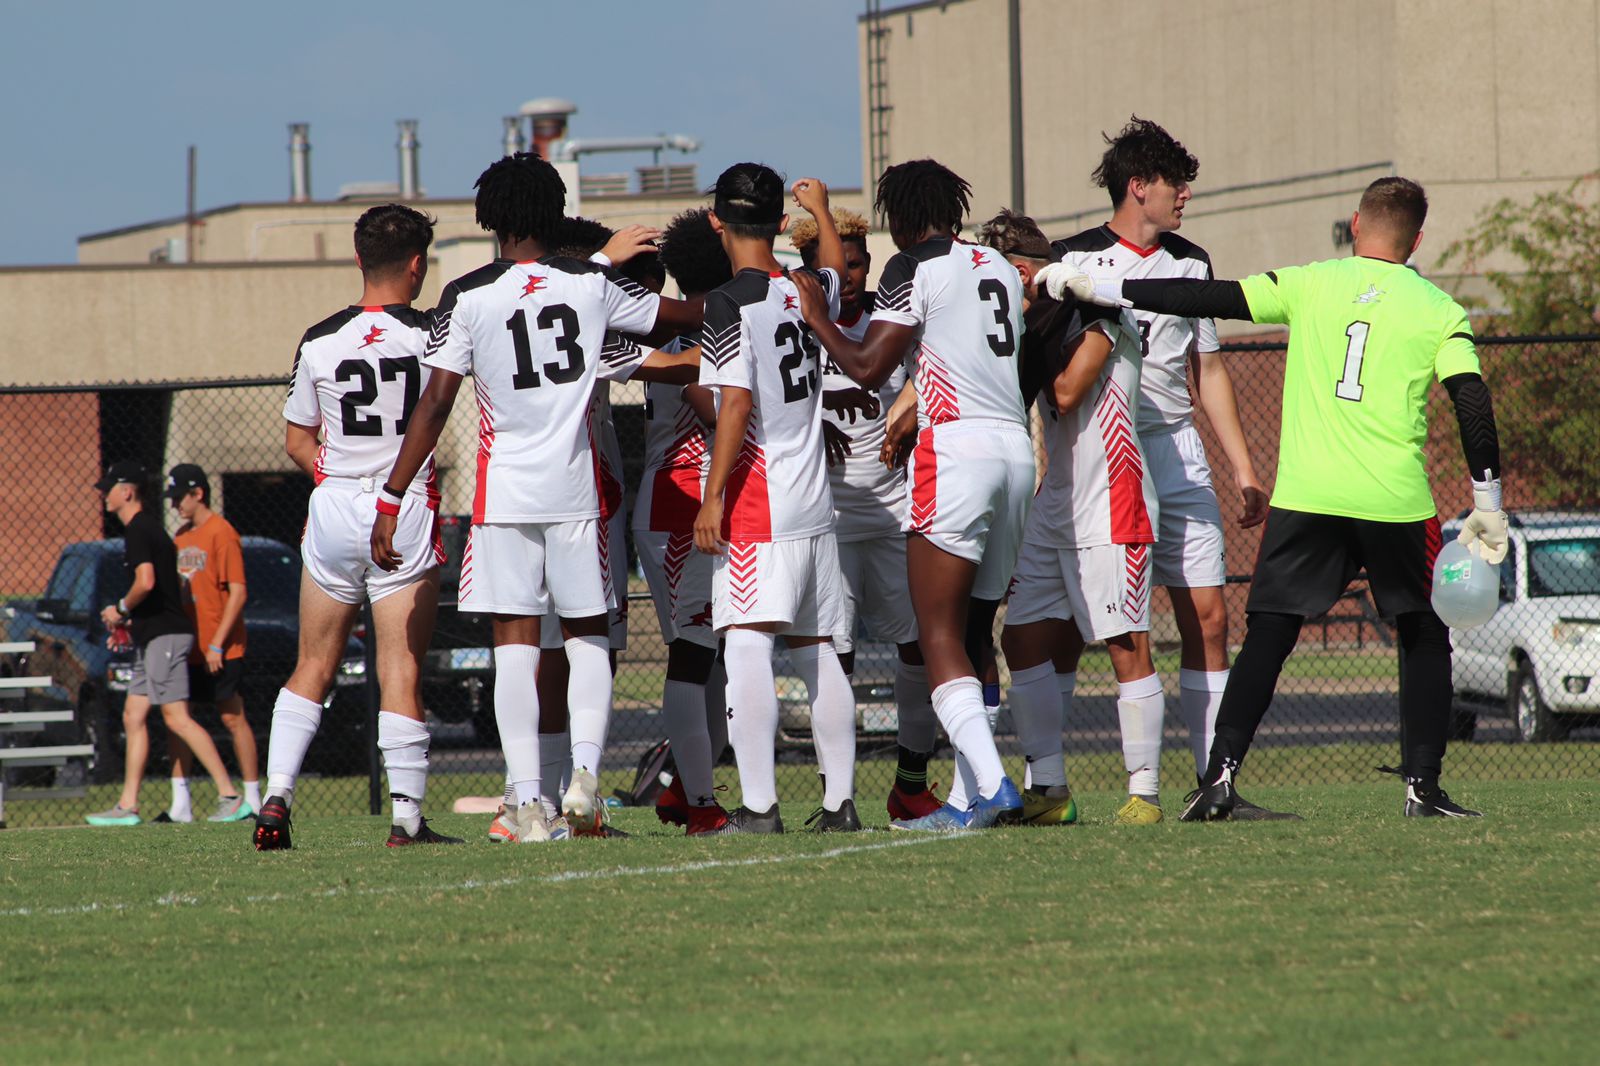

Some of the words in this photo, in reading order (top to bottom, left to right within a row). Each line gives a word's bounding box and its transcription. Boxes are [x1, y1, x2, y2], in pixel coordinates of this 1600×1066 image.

[506, 303, 586, 390] 13
[978, 278, 1015, 357] 3
[335, 355, 420, 436] 27
[1335, 319, 1370, 402] 1
